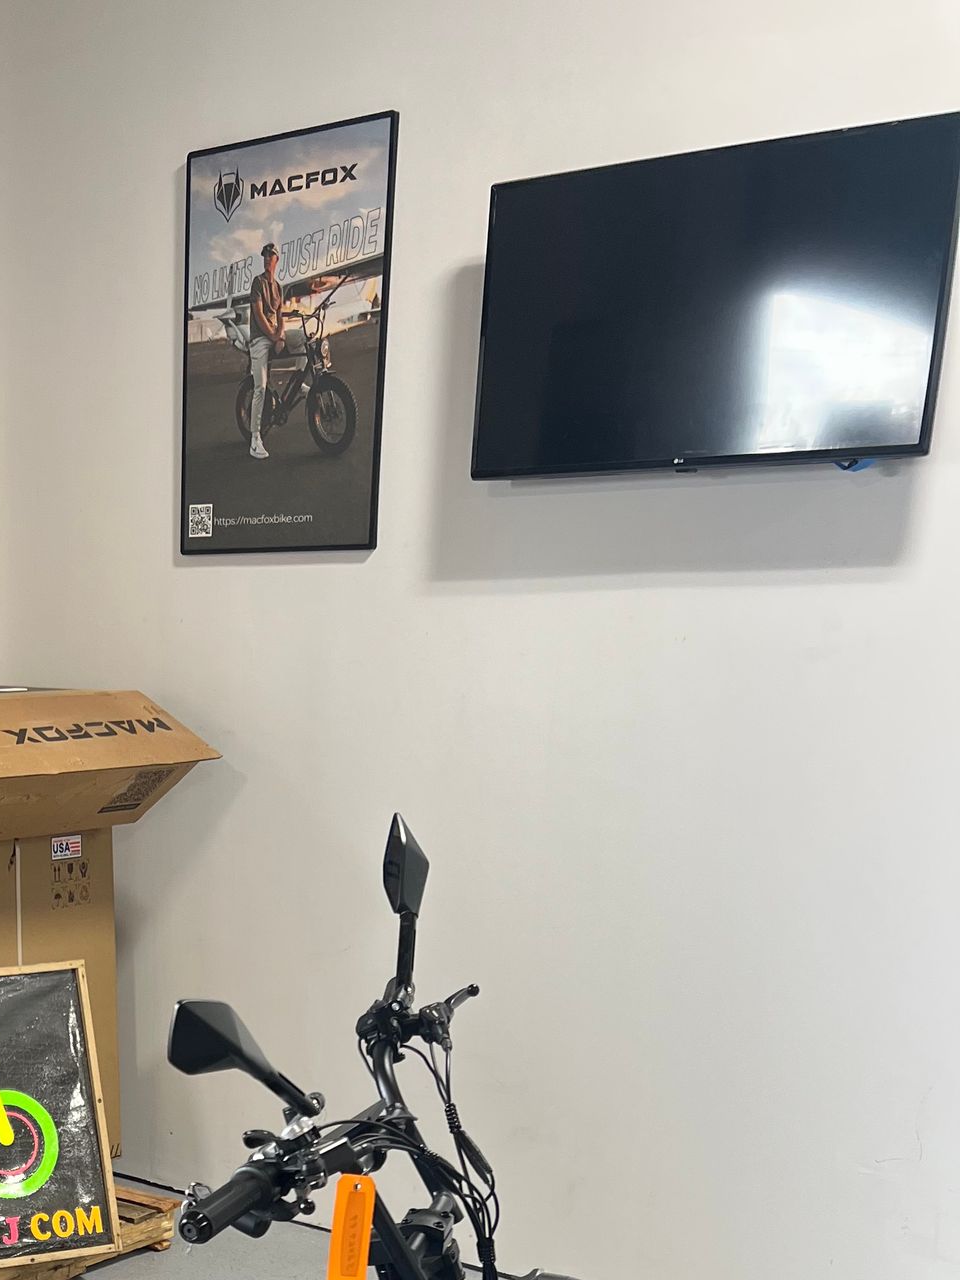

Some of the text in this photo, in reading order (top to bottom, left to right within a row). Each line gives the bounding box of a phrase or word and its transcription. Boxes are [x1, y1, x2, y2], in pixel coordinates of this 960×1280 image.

[250, 162, 358, 200] MACFOX
[192, 271, 209, 305] NO
[277, 229, 324, 281] JUST
[325, 207, 382, 267] RIDE
[213, 513, 313, 528] https://macfoxbike.com
[1, 717, 173, 745] MACFOX
[53, 842, 71, 855] USA
